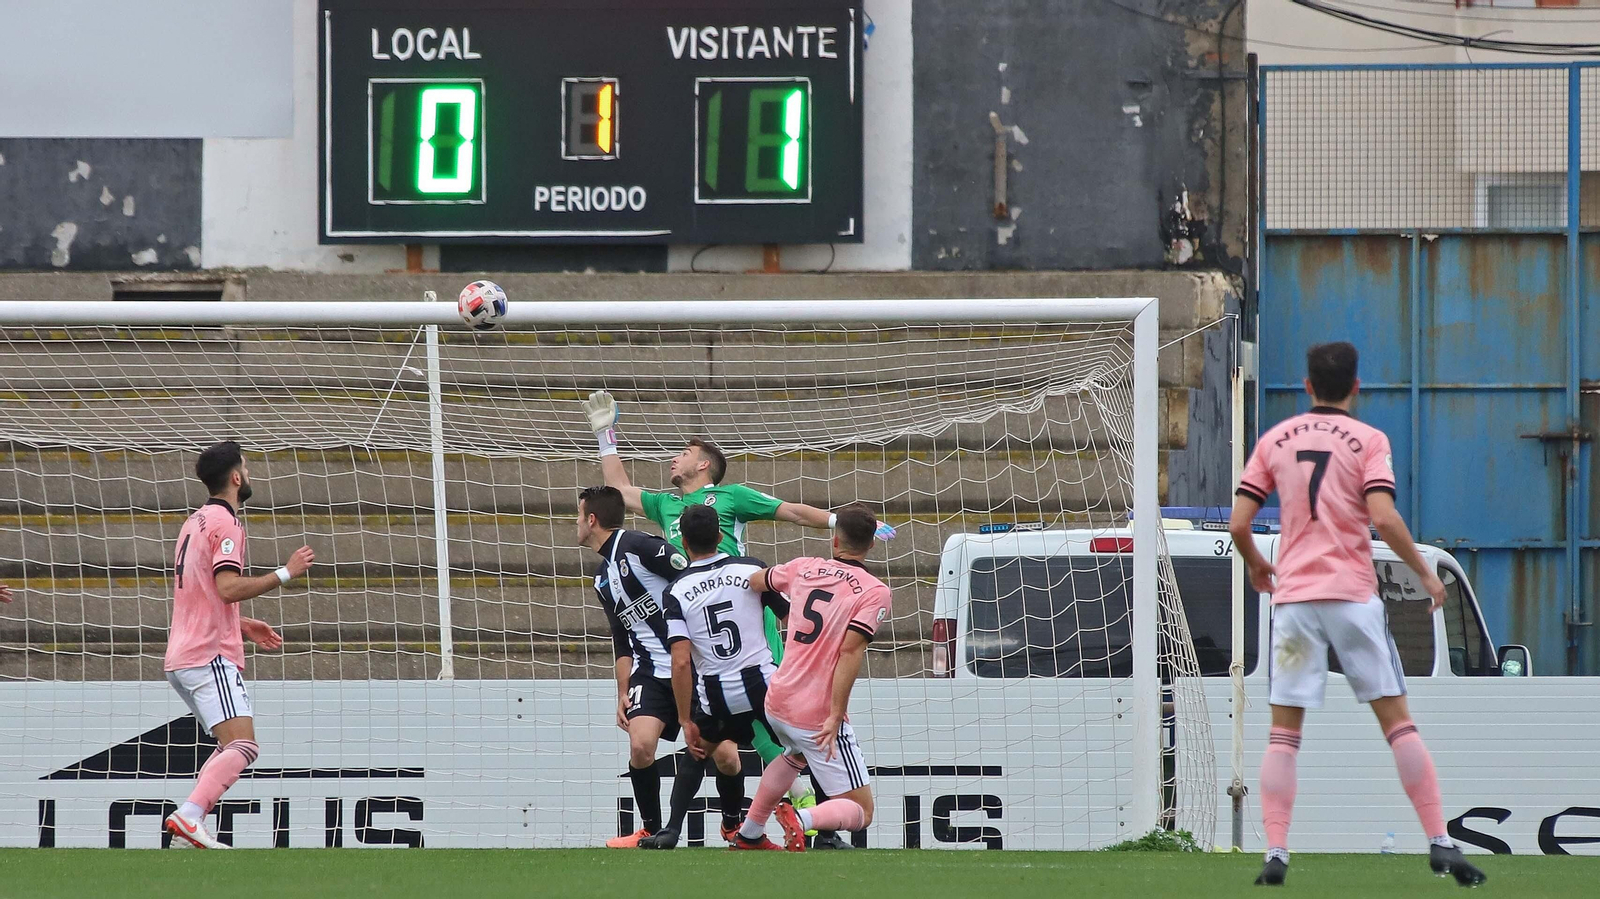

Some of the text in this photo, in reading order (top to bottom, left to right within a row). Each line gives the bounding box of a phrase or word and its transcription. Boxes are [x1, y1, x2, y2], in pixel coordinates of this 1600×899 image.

[371, 27, 481, 60] LOCAL
[667, 26, 838, 60] VISITANTE
[417, 87, 477, 194] 0
[597, 84, 612, 154] 1
[782, 88, 804, 191] 1
[534, 185, 647, 213] PERIODO
[1275, 421, 1363, 454] NACHO
[1296, 449, 1333, 521] 7
[175, 533, 191, 589] 4
[684, 575, 750, 602] CARRASCO
[702, 599, 743, 661] 5
[793, 588, 835, 645] 5
